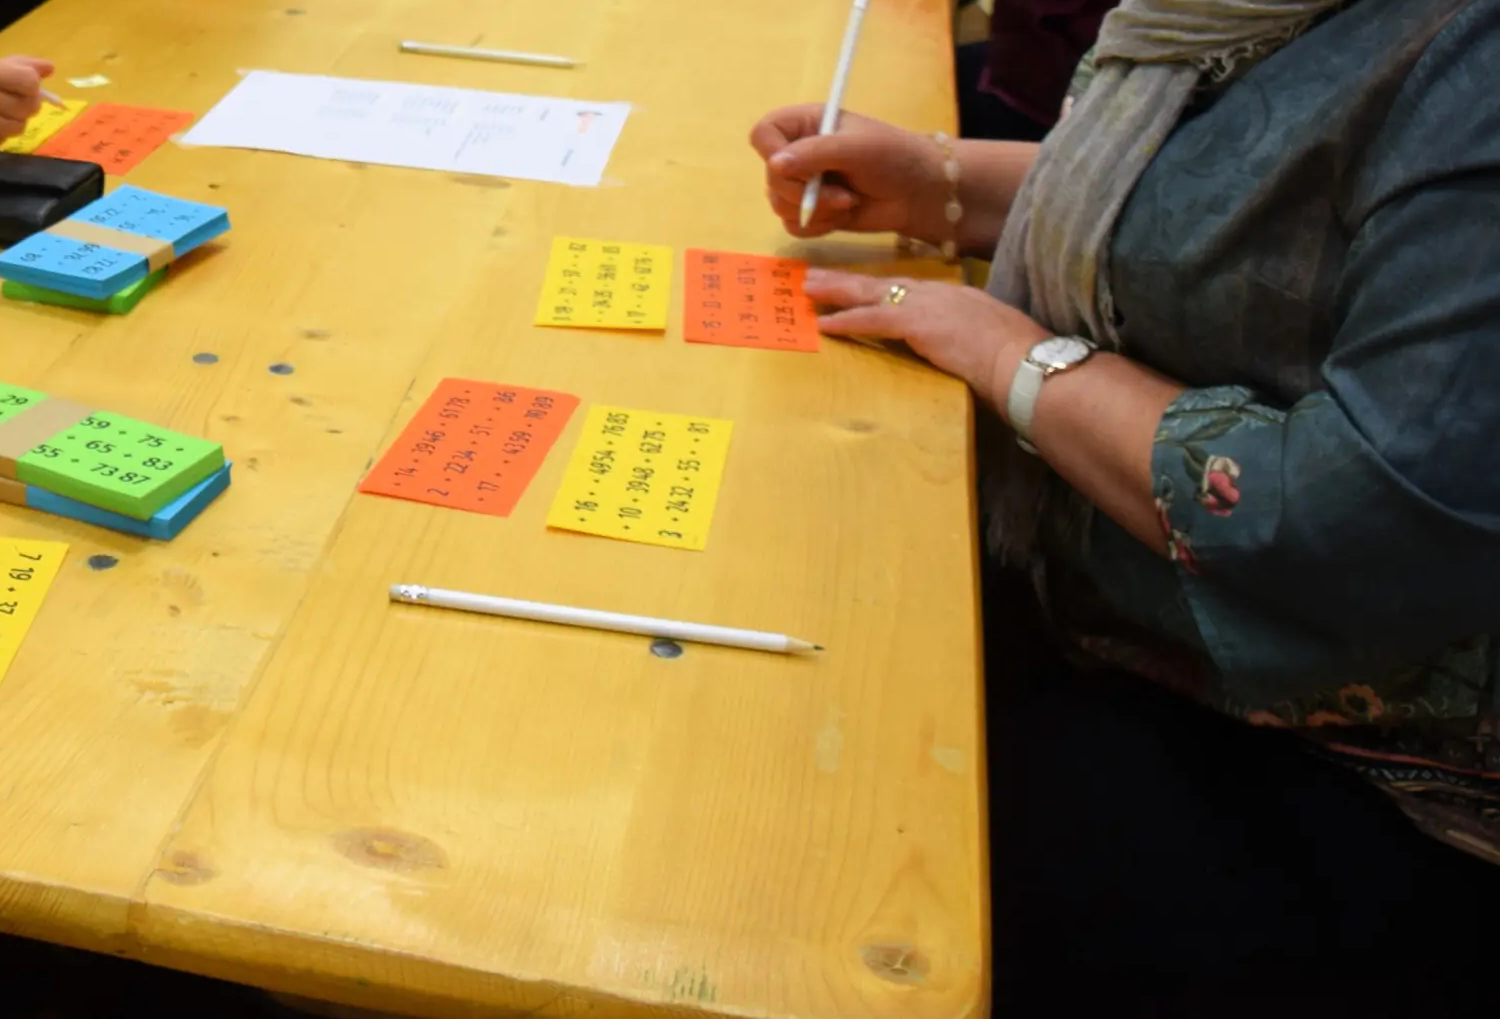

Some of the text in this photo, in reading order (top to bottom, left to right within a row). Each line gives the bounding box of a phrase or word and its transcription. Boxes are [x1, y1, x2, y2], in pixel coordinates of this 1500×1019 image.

[0, 395, 28, 405] 29
[81, 416, 110, 428] 59
[138, 434, 165, 447] 75
[31, 444, 61, 457] 55
[91, 463, 119, 476] 73
[119, 472, 150, 484] 87
[86, 440, 114, 453] 65
[142, 457, 173, 470] 83
[427, 488, 449, 496] 2
[469, 424, 491, 436] 51
[394, 468, 417, 476] 14
[574, 500, 598, 511] 16
[618, 507, 642, 518] 10
[658, 530, 682, 539] 3
[677, 460, 700, 471] 55
[9, 568, 34, 581] 19
